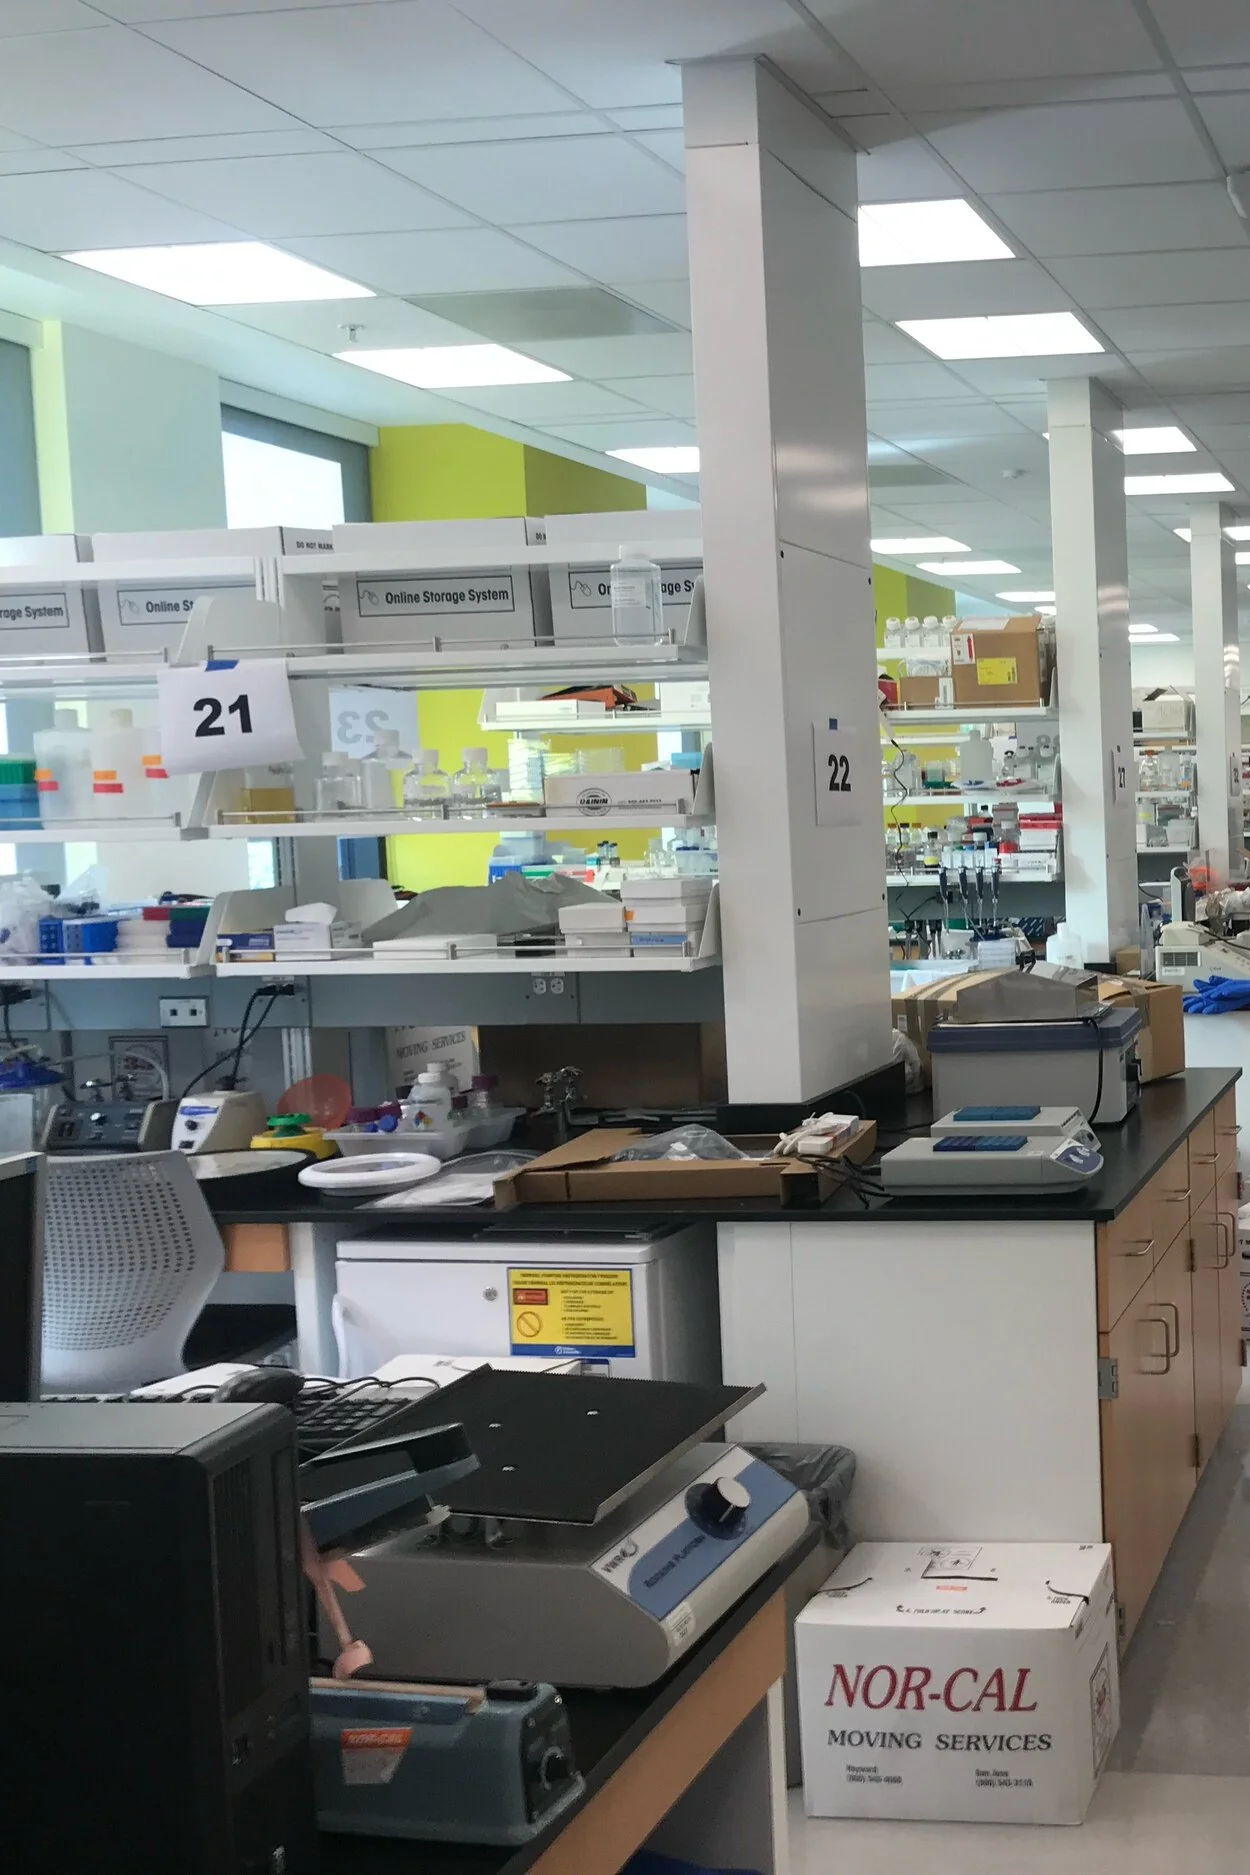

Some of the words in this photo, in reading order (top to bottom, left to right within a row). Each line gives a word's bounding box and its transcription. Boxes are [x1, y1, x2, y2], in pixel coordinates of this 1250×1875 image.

[146, 599, 181, 614] Online
[385, 591, 420, 605] Online
[423, 588, 466, 606] Storage
[468, 587, 509, 603] System
[25, 605, 64, 620] System
[193, 694, 253, 738] 21
[828, 754, 852, 792] 22
[824, 1663, 1038, 1713] NOR-CAL
[827, 1729, 922, 1749] MOVING
[935, 1732, 1052, 1751] SERVICES
